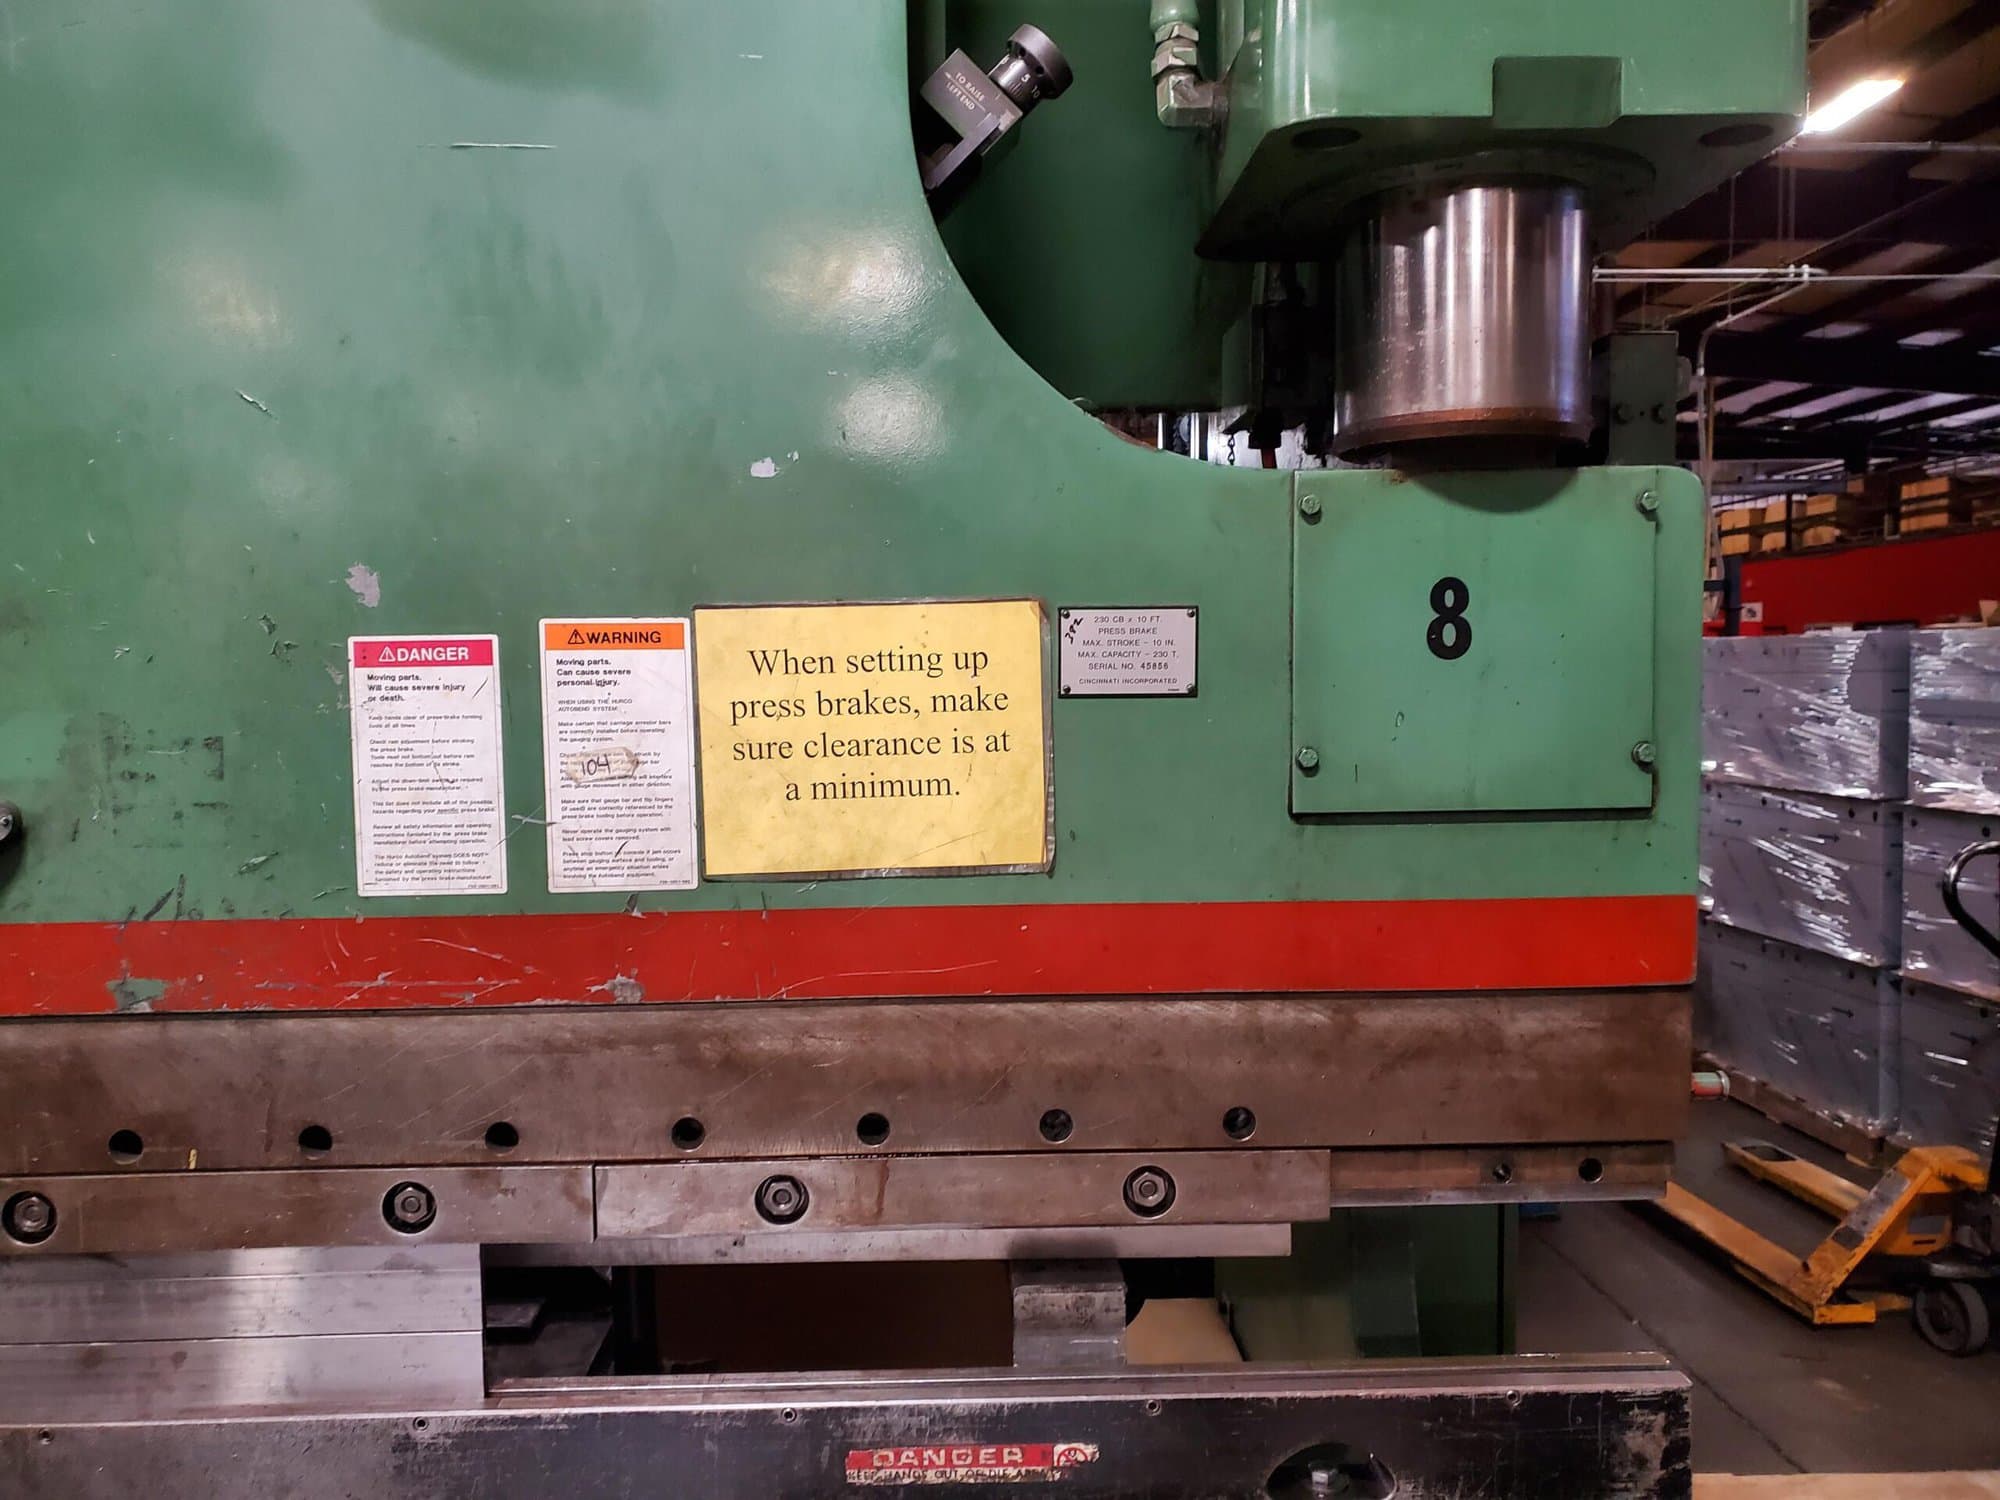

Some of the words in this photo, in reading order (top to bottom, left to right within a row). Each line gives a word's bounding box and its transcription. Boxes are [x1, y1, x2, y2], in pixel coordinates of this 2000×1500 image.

[959, 95, 976, 111] END
[1426, 576, 1472, 660] 8
[586, 631, 662, 644] WARNING
[397, 647, 470, 661] DANGER
[556, 658, 584, 667] Moving
[587, 658, 611, 667] parts.
[748, 648, 836, 676] When
[846, 645, 944, 679] setting
[954, 650, 989, 679] up
[1088, 662, 1118, 670] SERIAL
[366, 673, 396, 682] Moving
[398, 673, 421, 682] parts.
[556, 679, 592, 687] personal
[442, 683, 465, 692] injury
[729, 696, 806, 726] press
[815, 690, 921, 720] brakes,
[930, 686, 1009, 714] make
[733, 741, 794, 761] sure
[804, 732, 942, 758] clearance
[951, 728, 975, 755] is
[985, 729, 1011, 753] at
[581, 754, 611, 776] 104
[785, 781, 801, 801] a
[811, 773, 960, 801] minimum.
[872, 1448, 1024, 1466] DANGER
[934, 1470, 958, 1479] OUT
